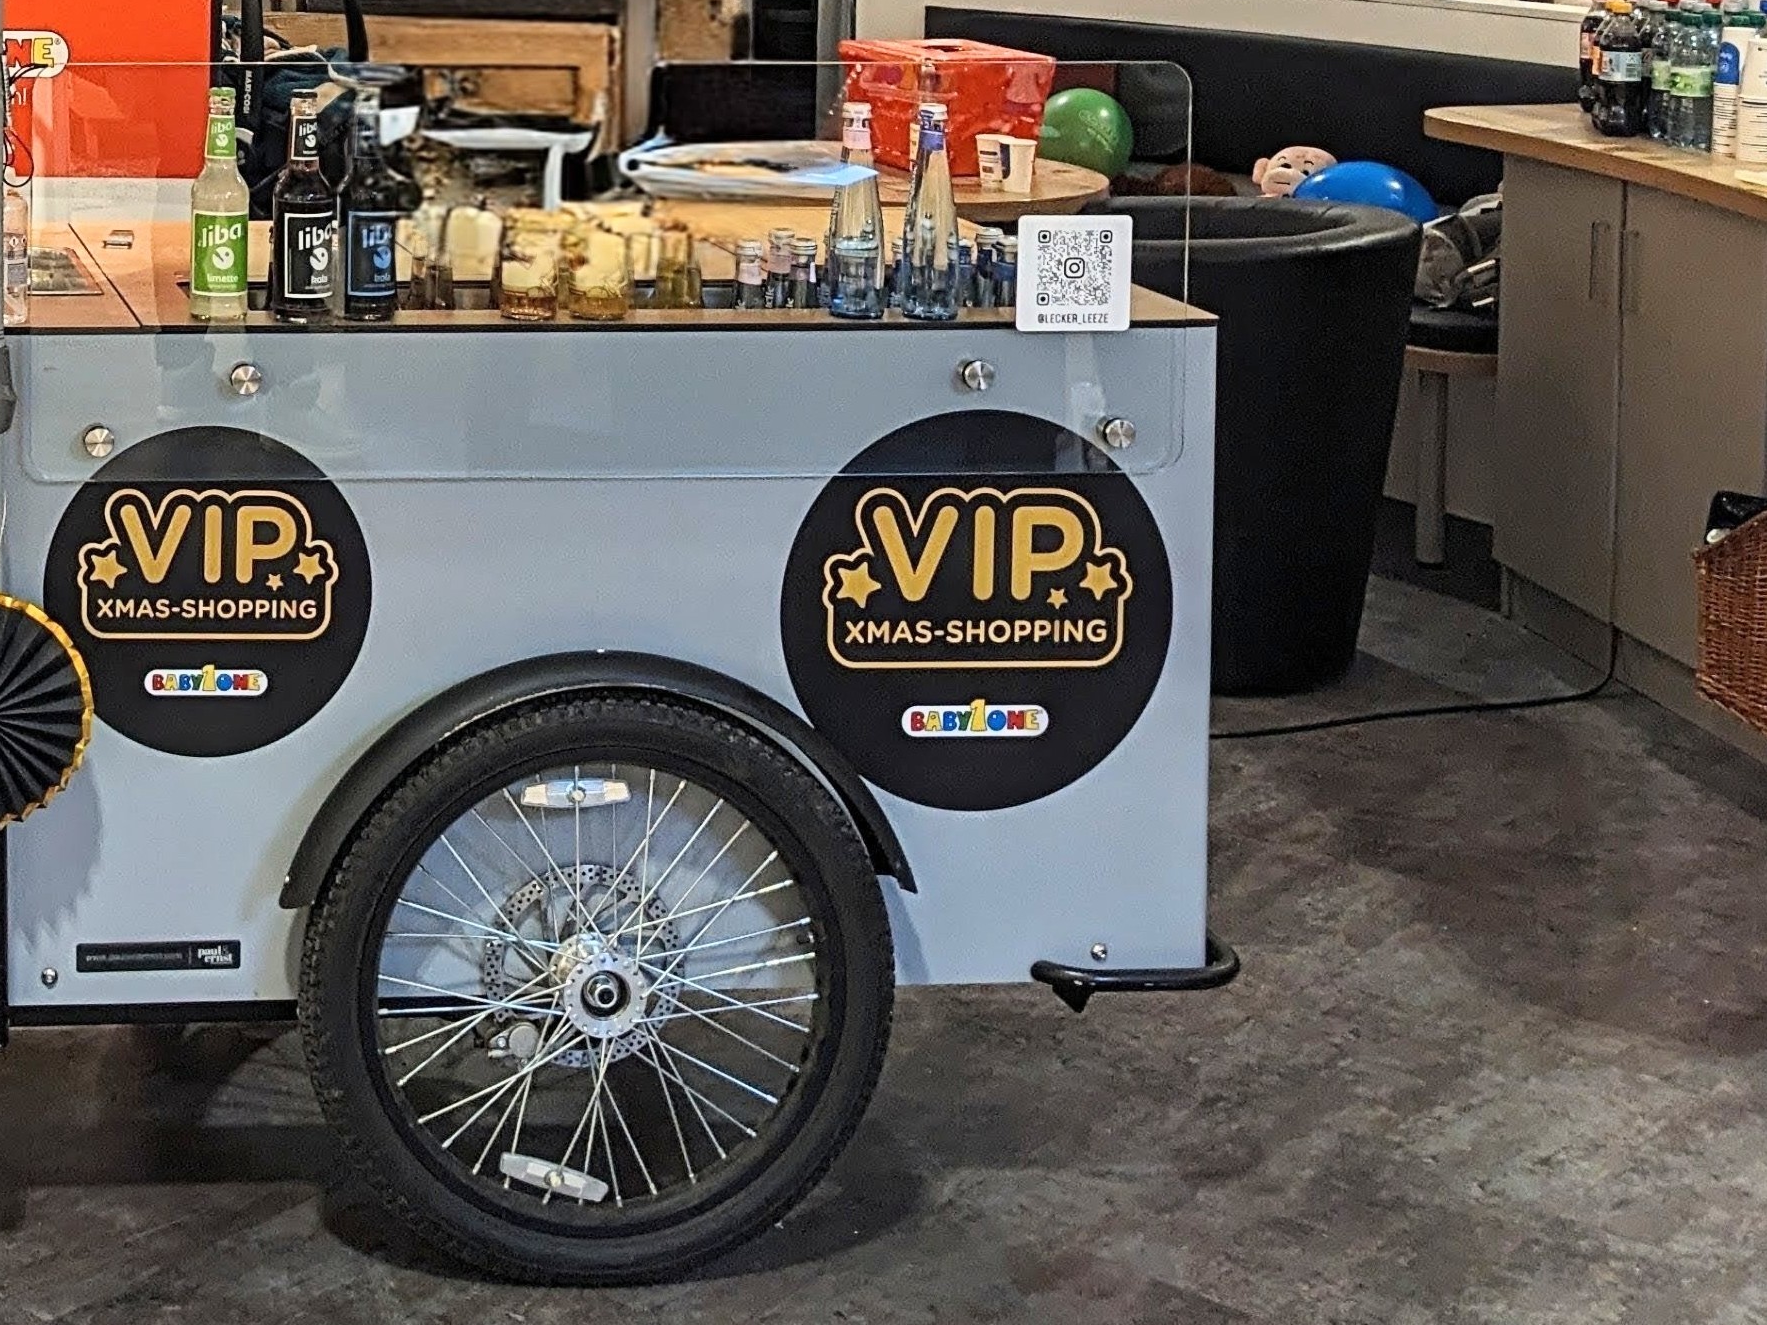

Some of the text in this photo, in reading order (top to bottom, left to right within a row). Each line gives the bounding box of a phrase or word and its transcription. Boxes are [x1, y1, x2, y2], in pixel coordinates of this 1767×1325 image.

[211, 122, 233, 134] liba
[200, 223, 242, 247] liba
[1037, 313, 1109, 325] @LECKER_LEEZE
[120, 504, 297, 584] VIP
[872, 505, 1084, 602] VIP
[97, 598, 317, 620] XMAS-SHOPPING
[845, 619, 1108, 644] XMAS-SHOPPING
